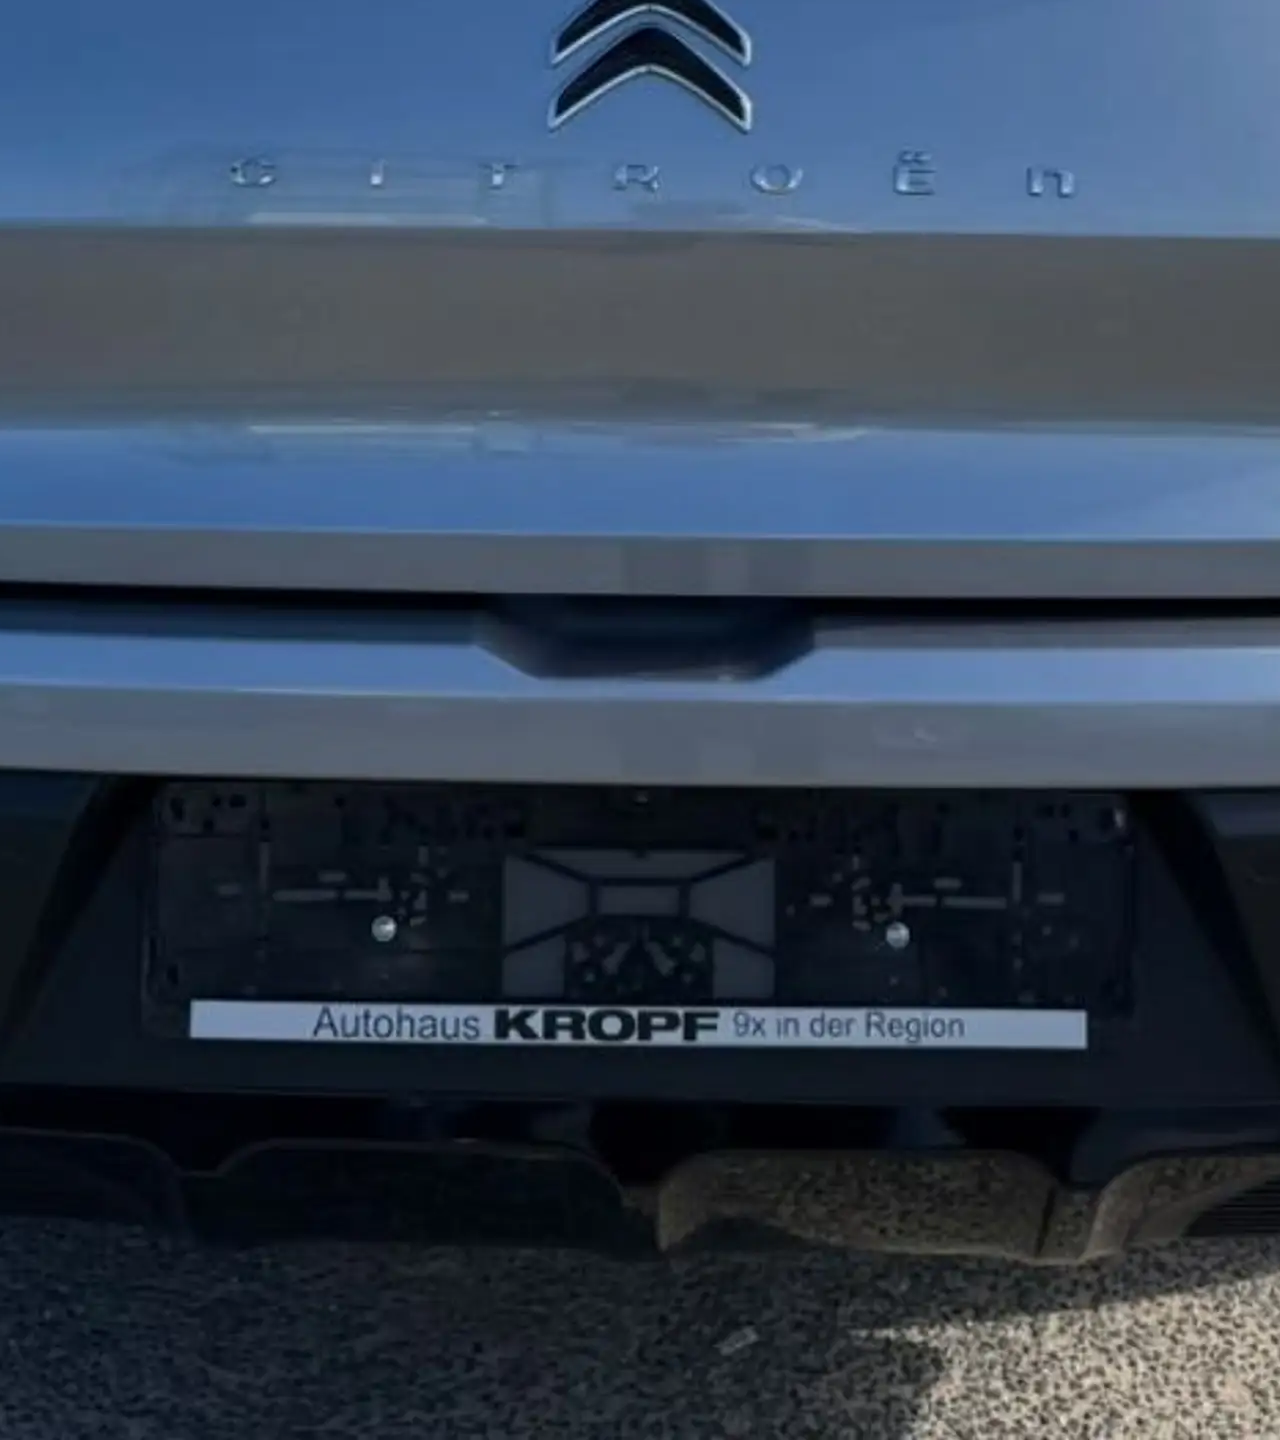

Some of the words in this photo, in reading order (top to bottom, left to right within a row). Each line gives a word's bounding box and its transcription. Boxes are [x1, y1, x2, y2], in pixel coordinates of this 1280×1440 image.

[312, 1006, 481, 1040] Autohaus
[492, 1008, 720, 1043] KROPF
[732, 1010, 767, 1039] 9x
[775, 1012, 801, 1039] in
[808, 1011, 857, 1040] der
[864, 1010, 967, 1045] Region
